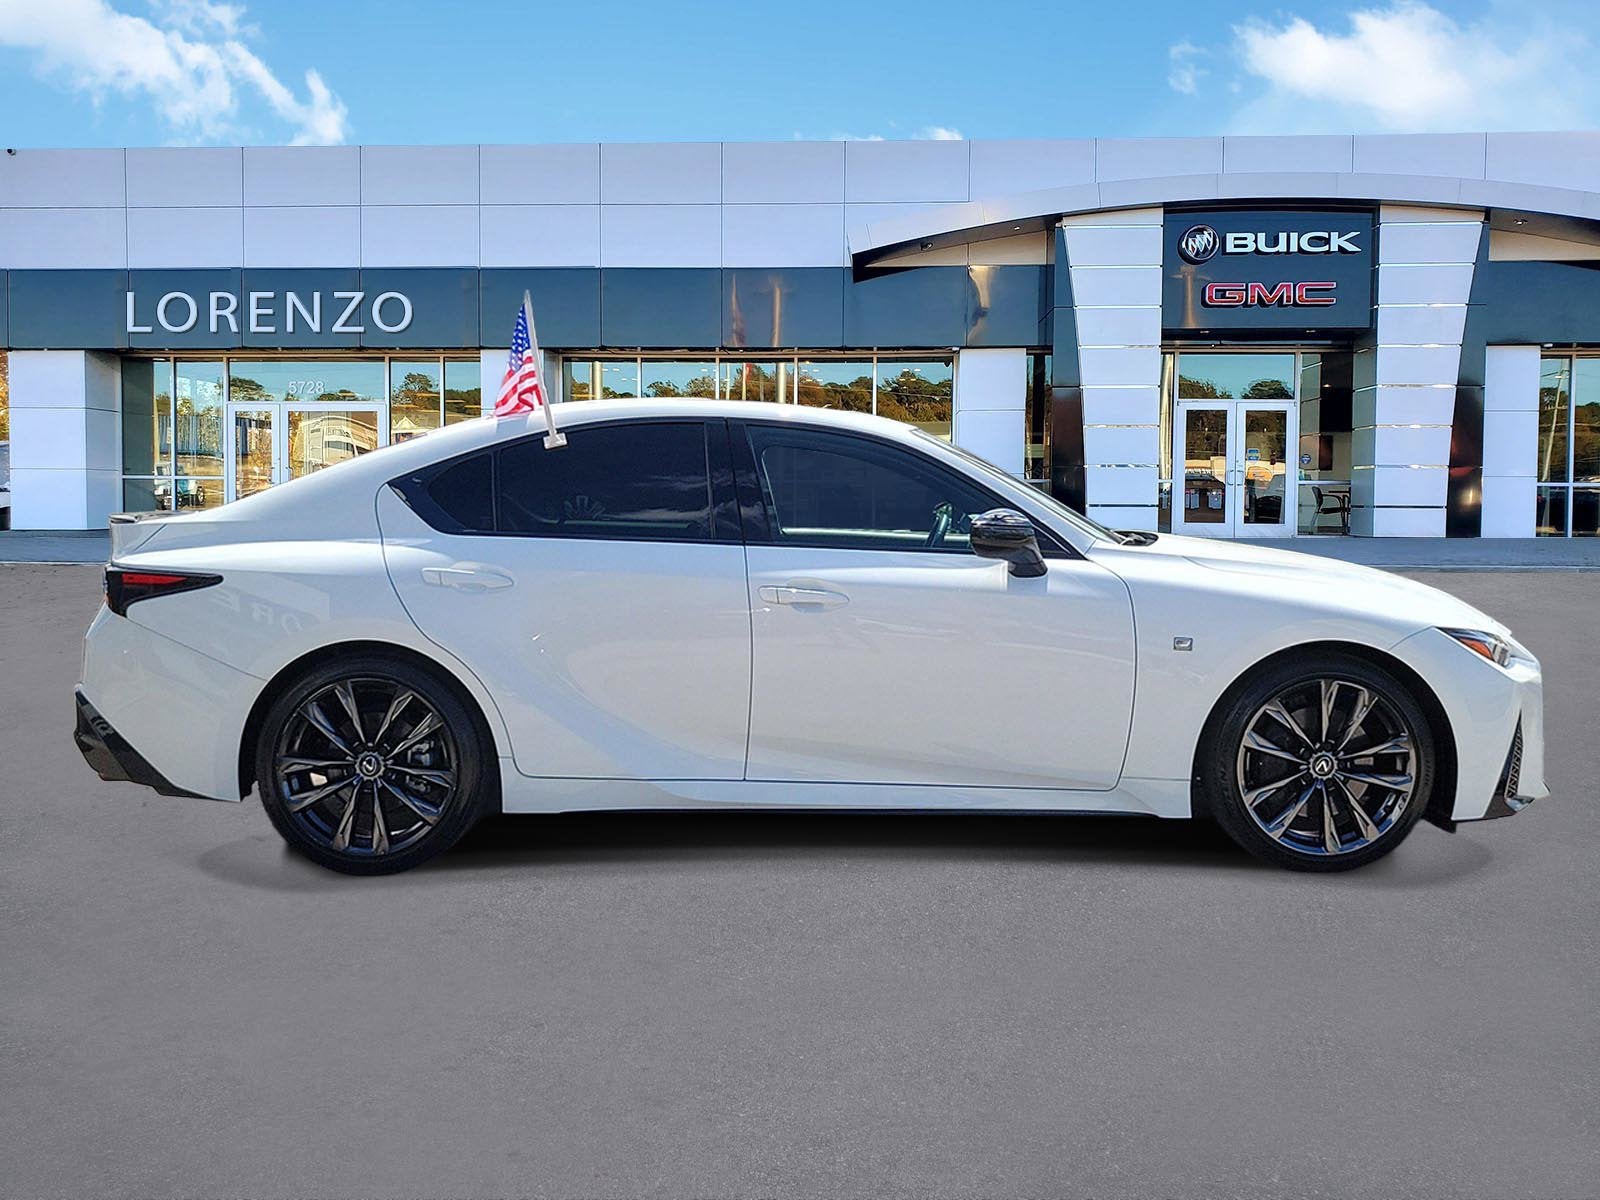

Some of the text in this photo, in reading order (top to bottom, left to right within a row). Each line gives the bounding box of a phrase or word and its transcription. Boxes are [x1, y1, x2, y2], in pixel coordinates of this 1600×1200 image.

[1226, 231, 1362, 253] BUICK
[1205, 282, 1337, 305] GMC
[126, 291, 413, 334] LORENZO
[289, 381, 325, 394] 5728
